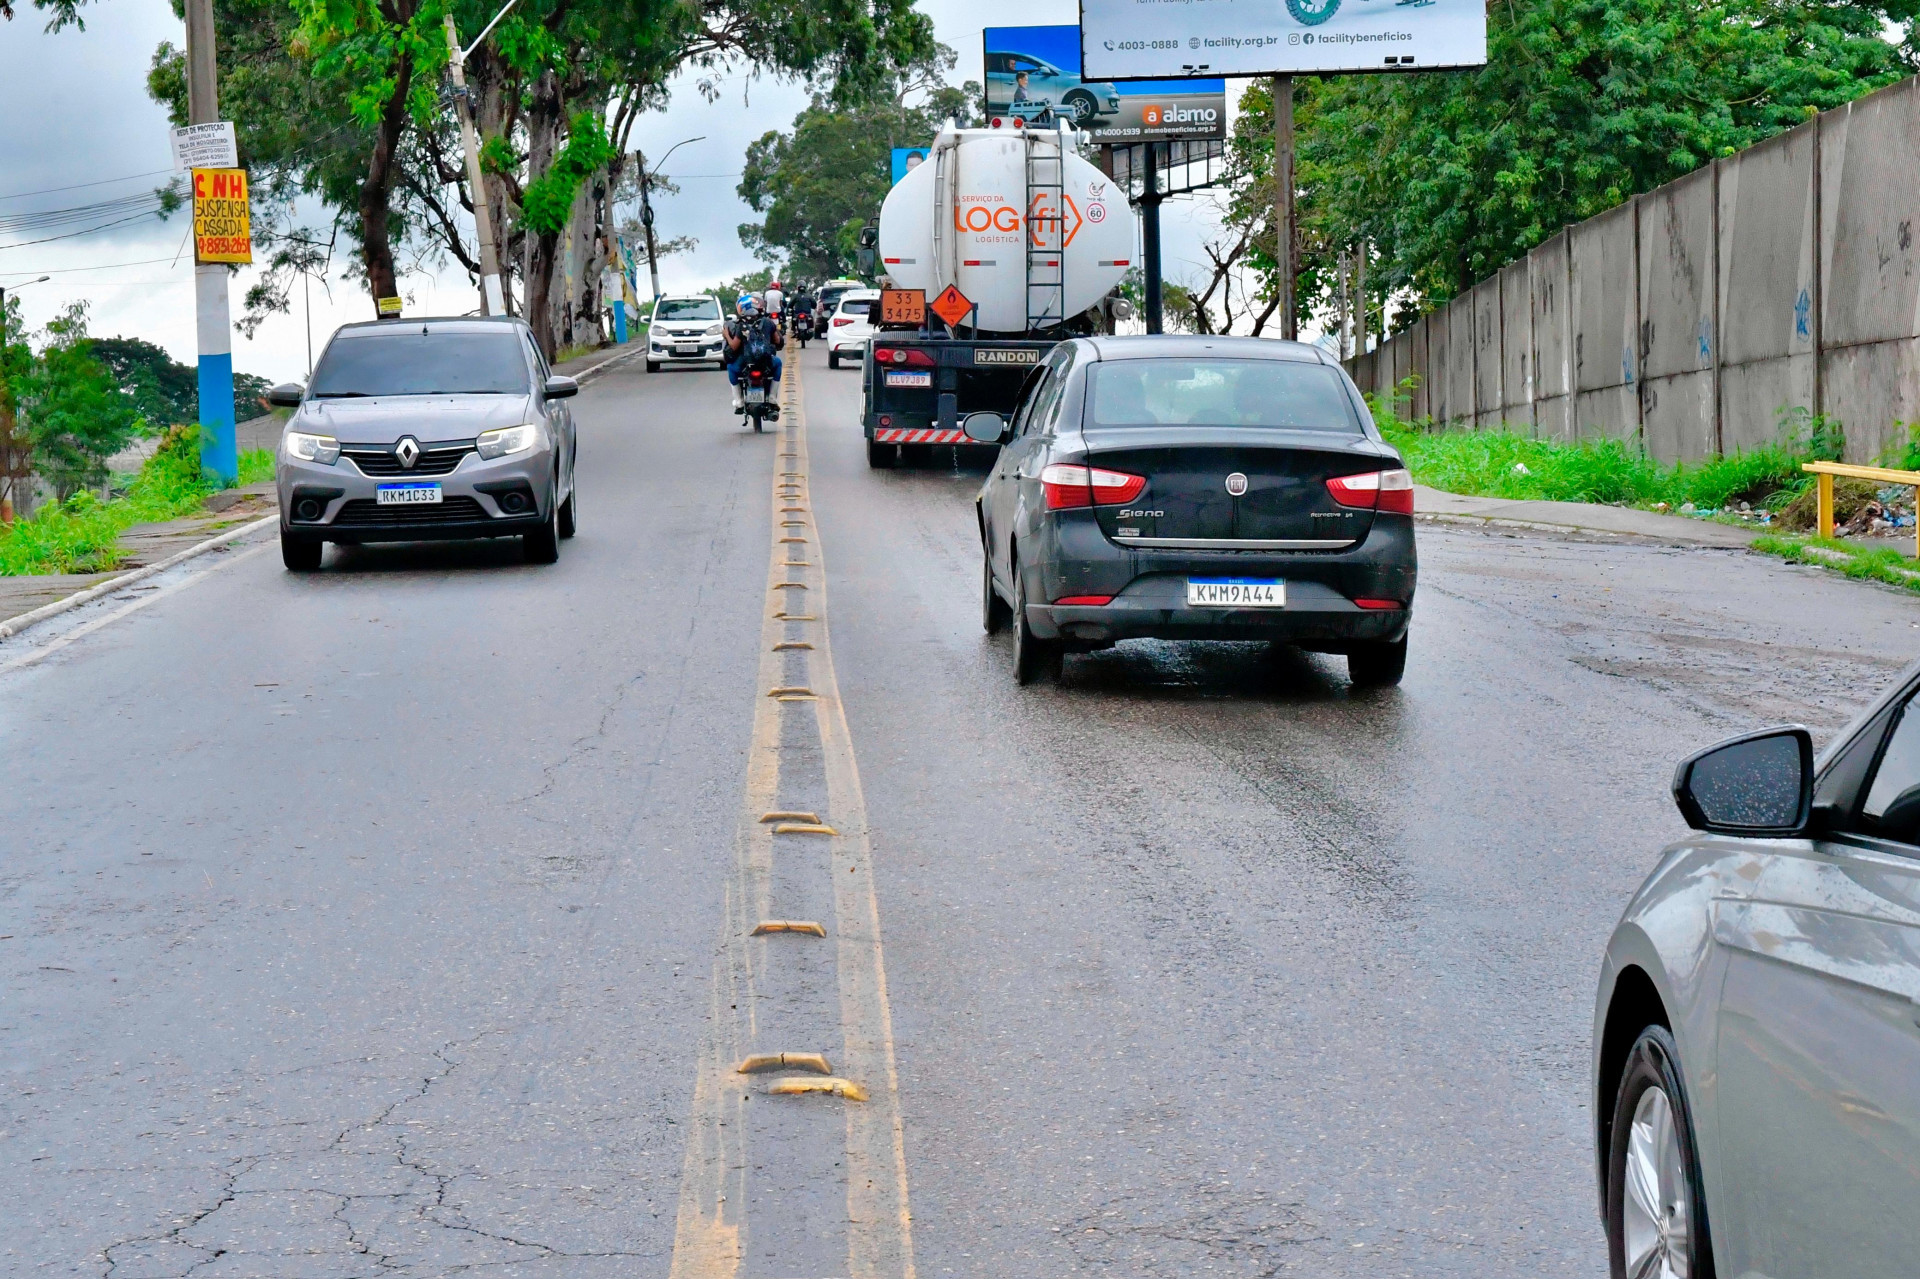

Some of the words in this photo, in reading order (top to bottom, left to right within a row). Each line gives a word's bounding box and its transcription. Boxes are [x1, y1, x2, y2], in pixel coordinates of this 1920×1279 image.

[1118, 40, 1179, 50] 4003-0888
[1204, 35, 1278, 48] facility.org.br
[1318, 31, 1413, 45] facilitybeneficios
[1163, 103, 1217, 123] alamo
[176, 129, 189, 137] REDE
[1102, 128, 1140, 136] 4000-1939
[1144, 125, 1217, 134] alamobeneficios.org.br
[961, 195, 992, 203] SERVIÇO
[195, 199, 247, 218] SUSPENSA
[1090, 210, 1102, 218] 60
[955, 206, 1019, 233] LOG
[195, 218, 244, 237] CASSADA
[886, 308, 921, 320] 3475
[977, 351, 1036, 362] RANDON
[890, 375, 926, 384] LLV7J89
[1230, 479, 1244, 490] FIAT
[383, 489, 435, 502] RKM1C33
[1116, 509, 1164, 519] Siena
[1197, 585, 1274, 602] KWM9A44
